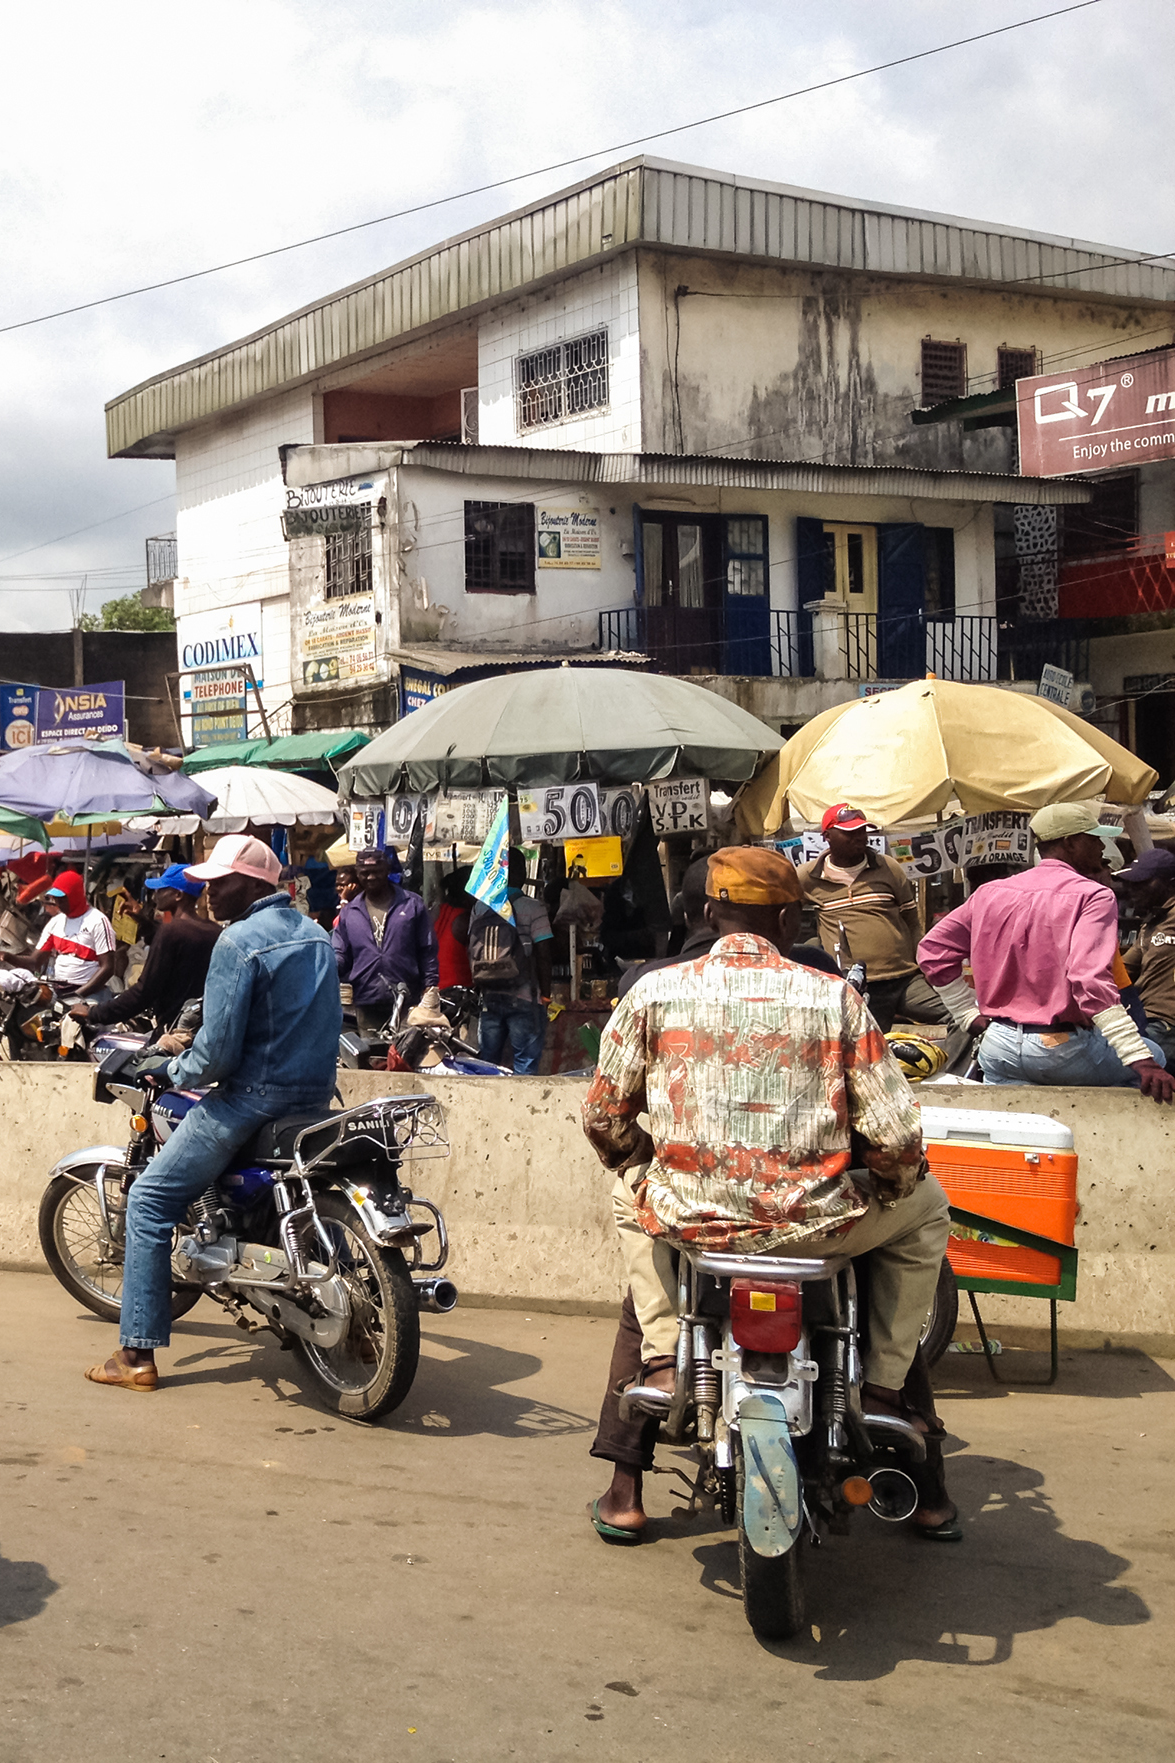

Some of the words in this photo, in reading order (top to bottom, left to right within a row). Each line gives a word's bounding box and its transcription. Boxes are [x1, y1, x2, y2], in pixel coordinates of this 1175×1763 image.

[1073, 443, 1108, 460] Enjoy
[1110, 438, 1131, 452] the
[570, 512, 597, 526] Moderne
[338, 602, 371, 618] Moderne
[183, 632, 259, 668] CODIMEX
[194, 681, 243, 698] TELEPHONE
[65, 693, 107, 711] NSIA
[68, 710, 104, 721] Assurances
[12, 731, 32, 744] ICI
[41, 728, 62, 738] ESPACE
[64, 727, 85, 736] DIRECT
[654, 781, 700, 798] Transfert
[544, 786, 597, 836] 50
[965, 811, 1031, 835] TRANSFERT
[989, 853, 1027, 863] ORANGE
